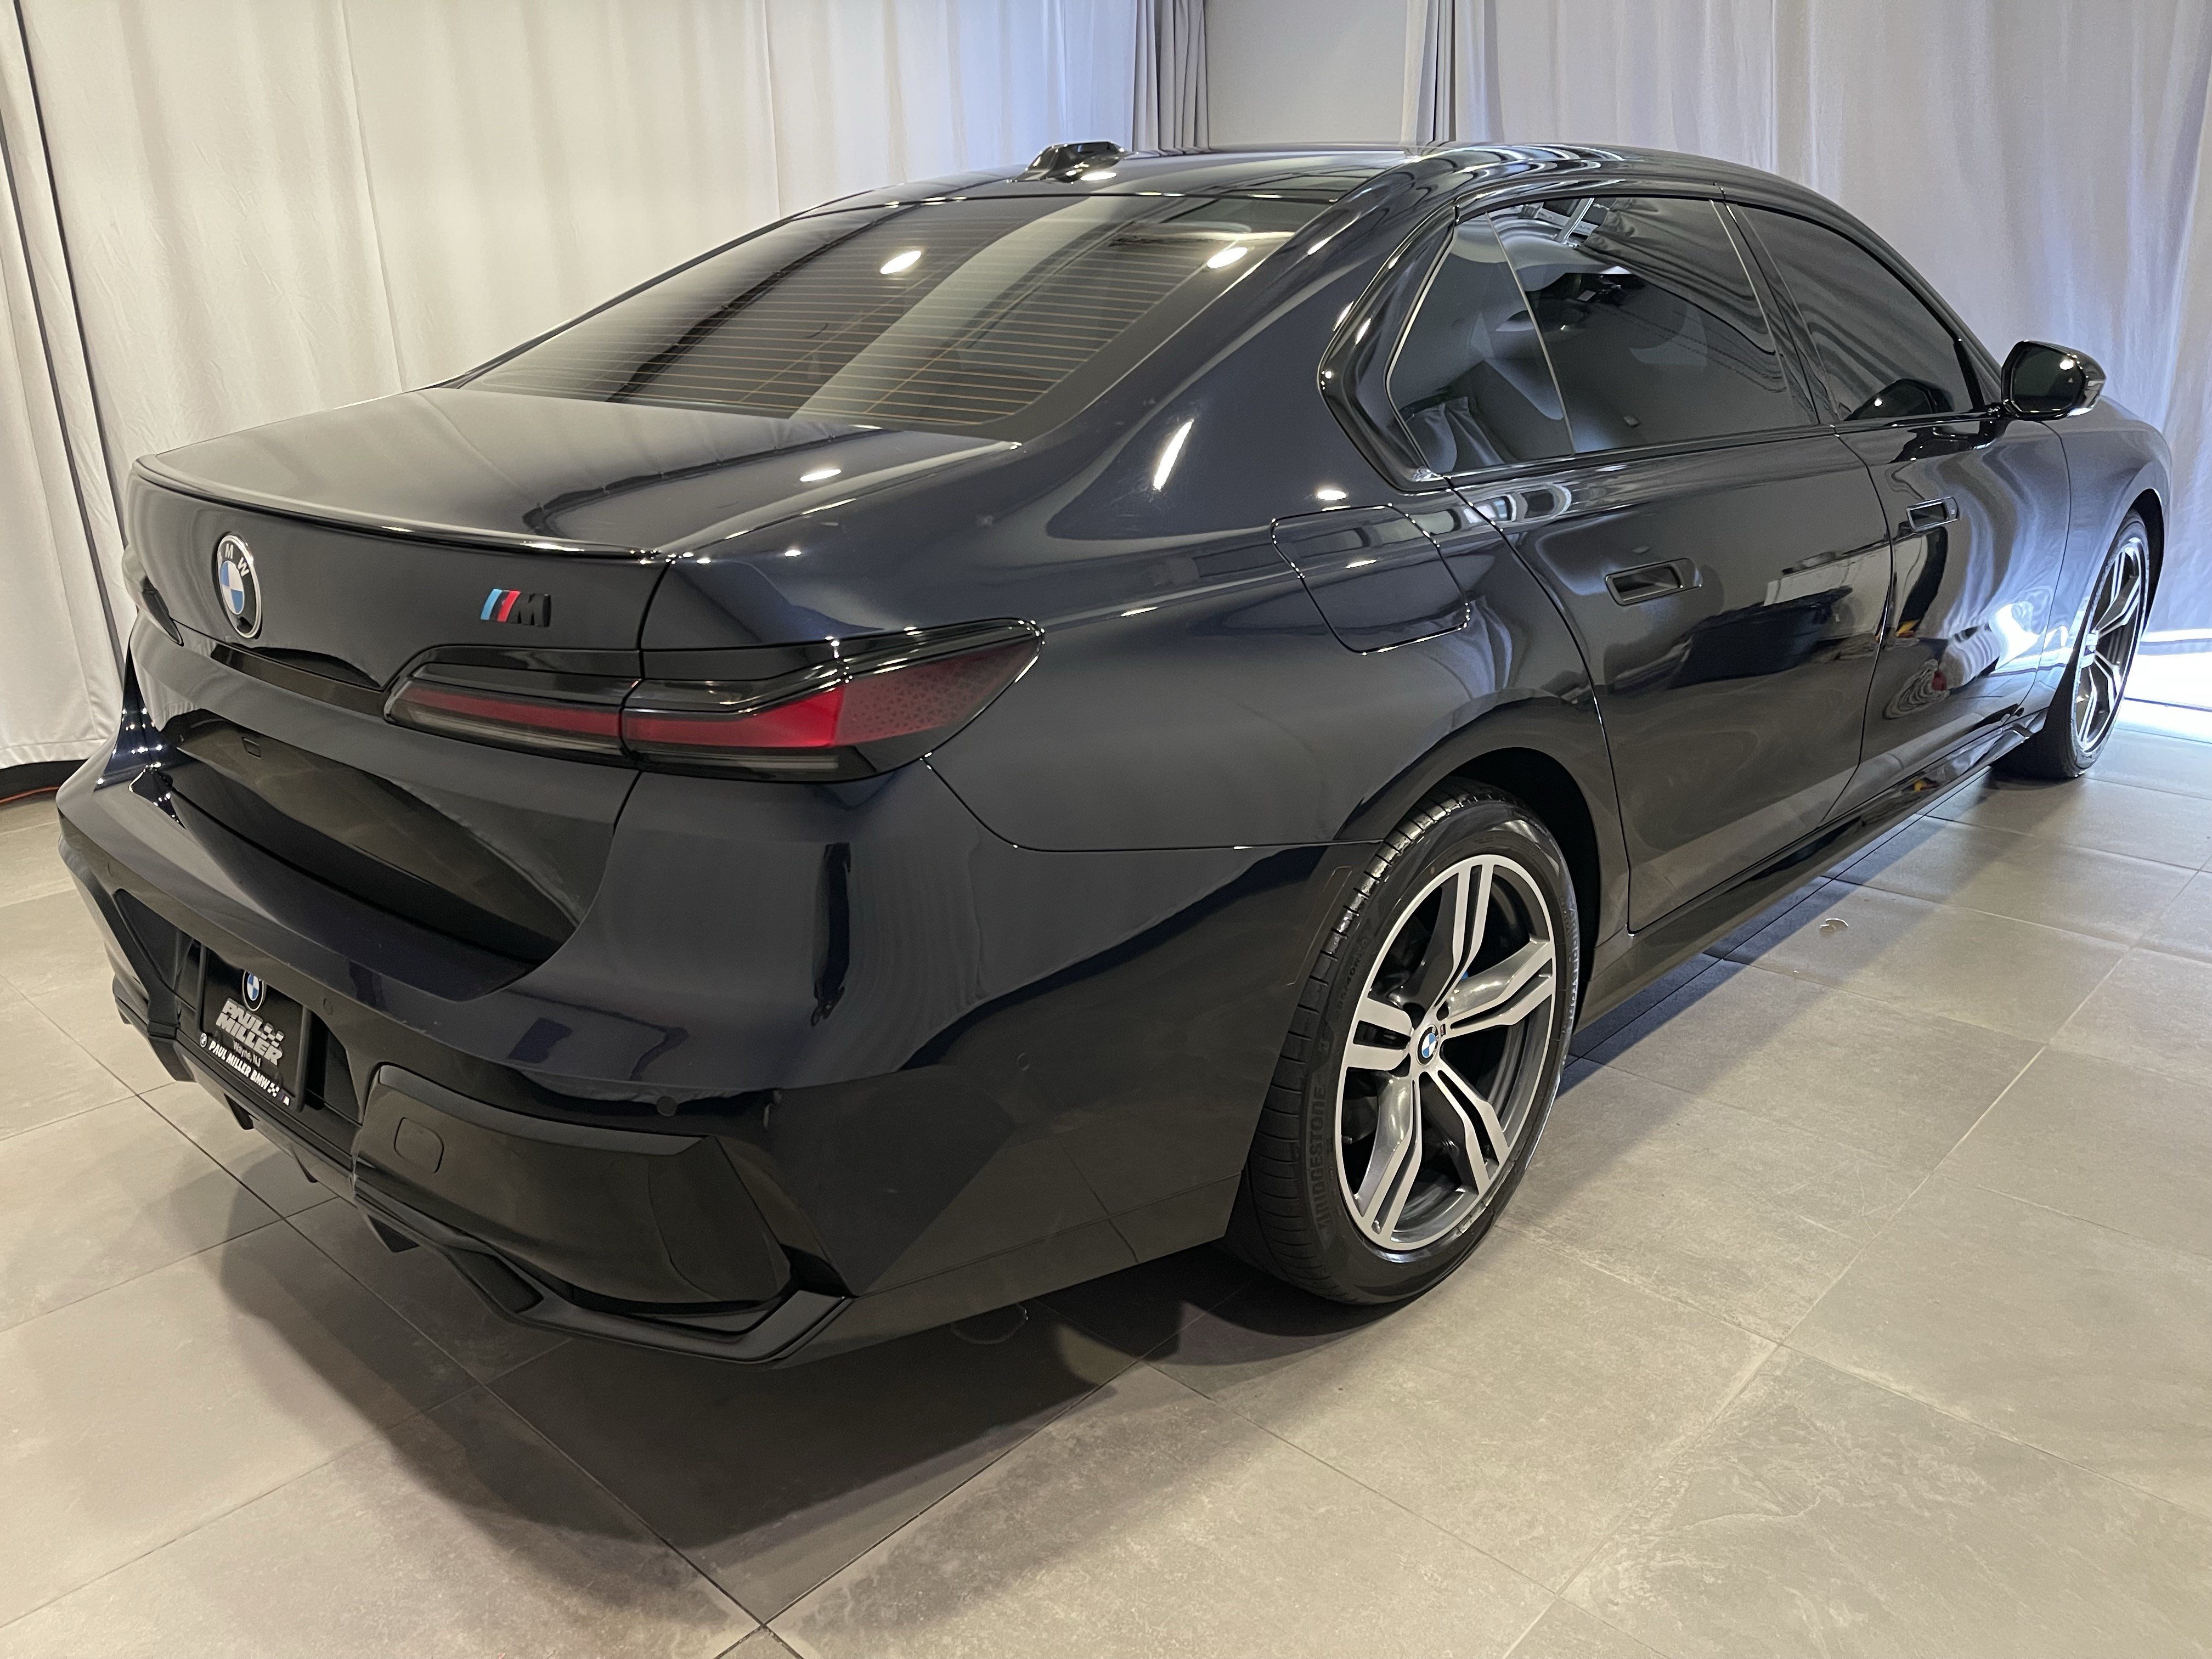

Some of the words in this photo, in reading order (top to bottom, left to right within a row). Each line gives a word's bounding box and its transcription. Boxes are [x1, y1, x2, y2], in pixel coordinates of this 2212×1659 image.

[216, 1012, 283, 1066] MILLER
[222, 998, 263, 1036] PAUL
[208, 1040, 228, 1060] PAUL
[225, 1053, 252, 1077] MILLER
[250, 1069, 270, 1090] BMW
